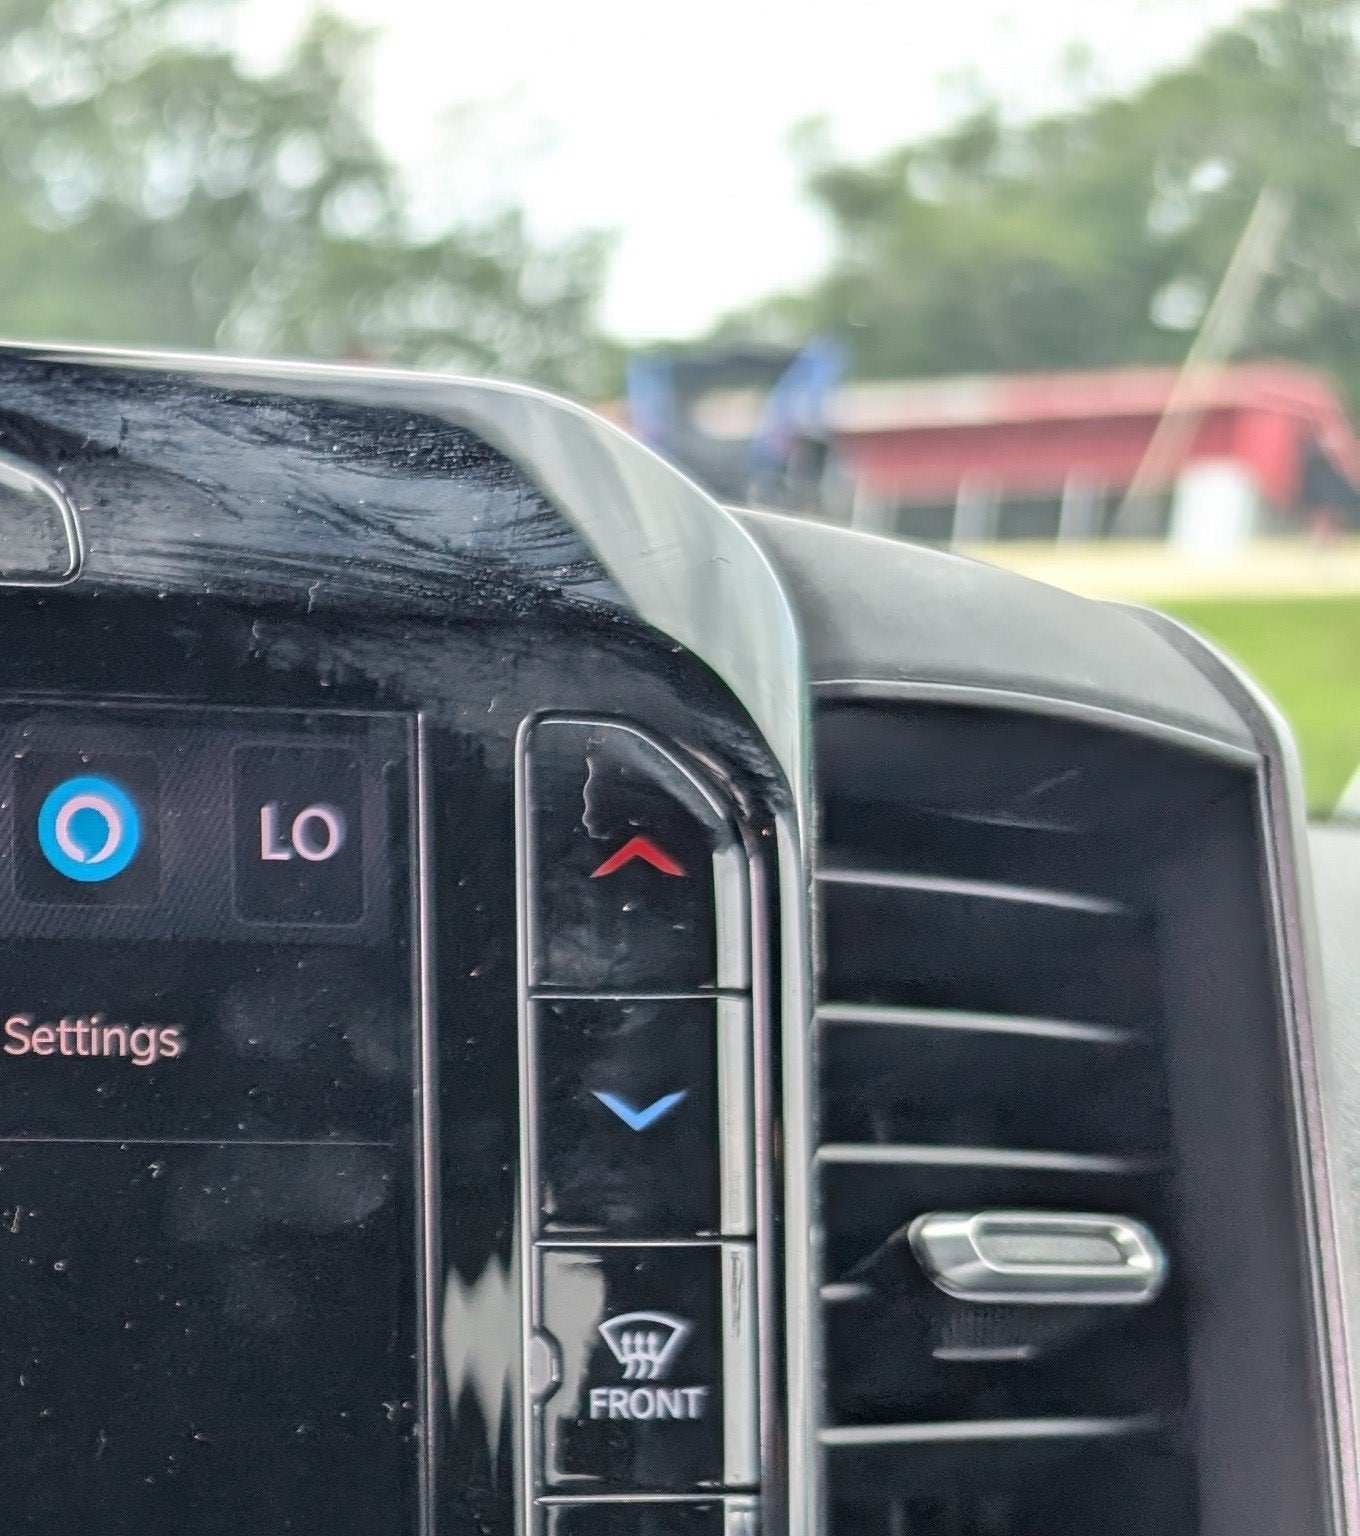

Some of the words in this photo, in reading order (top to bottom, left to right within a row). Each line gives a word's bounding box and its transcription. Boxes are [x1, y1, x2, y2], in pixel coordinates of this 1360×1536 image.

[260, 806, 340, 861] LO
[2, 1016, 181, 1066] Settings
[589, 1387, 704, 1420] FRONT
